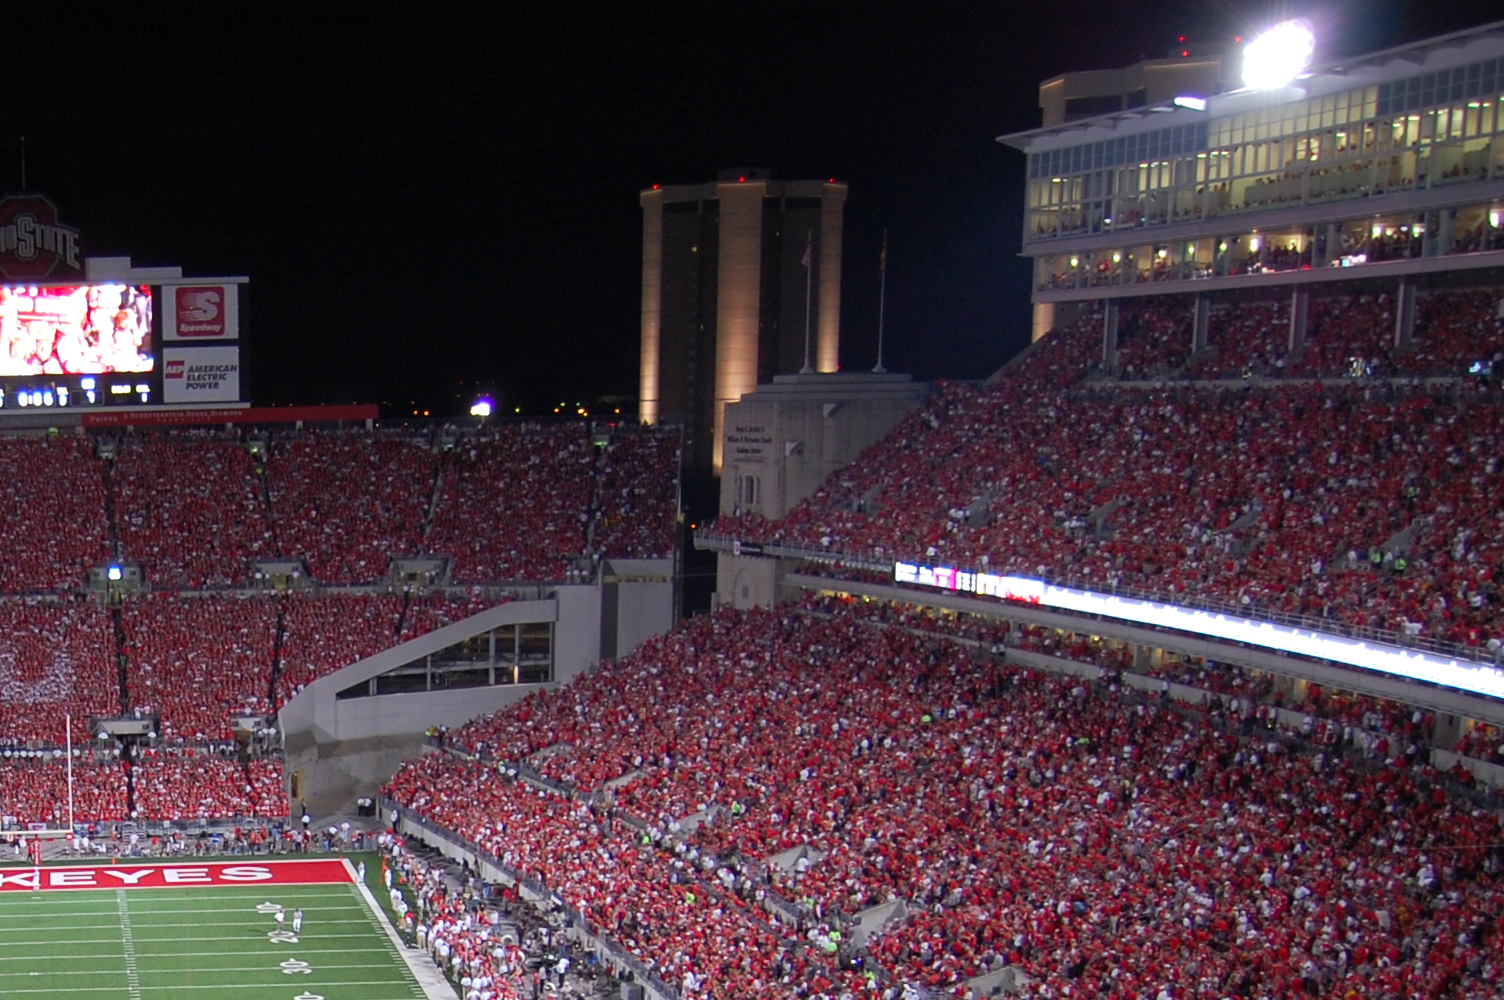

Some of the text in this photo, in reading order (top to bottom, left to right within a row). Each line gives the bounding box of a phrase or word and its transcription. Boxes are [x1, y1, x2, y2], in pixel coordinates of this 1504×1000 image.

[17, 216, 81, 270] STATE
[180, 323, 222, 333] Speedway
[165, 365, 184, 374] AEP
[187, 364, 237, 373] AMERICAN
[187, 373, 228, 381] ELECTRIC
[186, 382, 220, 390] POWER
[279, 960, 313, 974] 30
